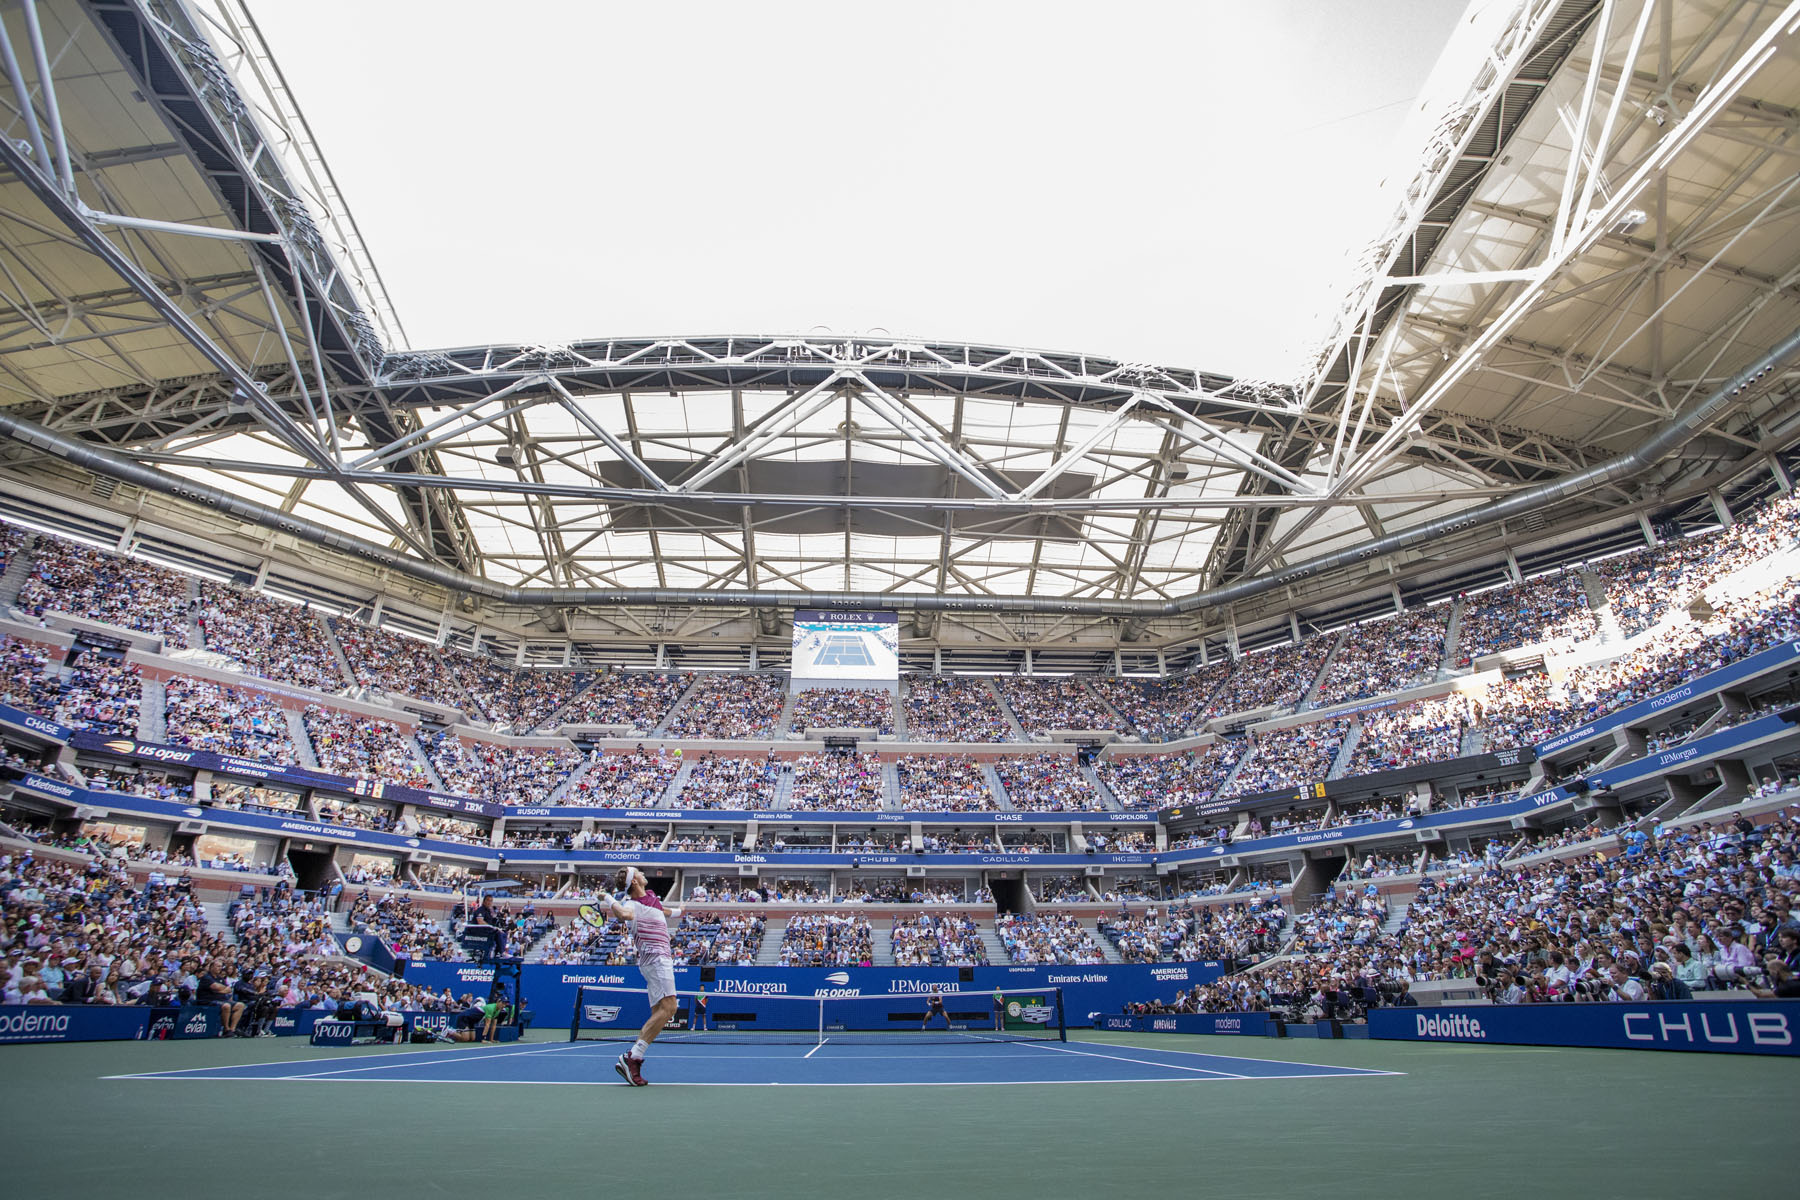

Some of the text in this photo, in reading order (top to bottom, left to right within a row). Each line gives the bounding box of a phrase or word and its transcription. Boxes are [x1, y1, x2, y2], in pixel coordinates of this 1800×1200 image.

[1650, 687, 1692, 708] moderna
[25, 717, 60, 735] CHASE
[1542, 726, 1594, 752] AMERICAN EXPRESS
[137, 745, 193, 762] us open
[1659, 747, 1698, 766] J.P.Morgan
[229, 758, 250, 767] KAREN
[250, 762, 287, 773] KHACHANOV
[1499, 755, 1520, 767] IBM
[227, 766, 250, 775] CASPER
[250, 769, 269, 778] RUUD
[26, 777, 74, 797] ticketmaster
[1215, 799, 1241, 807] KHACHANOV
[1534, 791, 1559, 806] WTA
[464, 801, 485, 813] IBM
[877, 814, 905, 822] J.P.Morgan
[281, 822, 357, 838] AMERICAN EXPRESS
[1297, 831, 1343, 843] Emirates Airline
[604, 852, 641, 860] moderna
[734, 854, 767, 863] Deloitte.
[1150, 967, 1187, 975] AMERICAN
[562, 974, 625, 984] Emirates Airline
[1048, 974, 1108, 983] Emirates Airline
[714, 979, 788, 995] J.P.Morgan
[814, 988, 859, 998] us open
[153, 1021, 174, 1031] evian
[185, 1022, 207, 1033] evian
[275, 1017, 295, 1027] Wilson
[1108, 1018, 1132, 1028] CADILLAC
[1215, 1016, 1241, 1029] moderna
[1416, 1013, 1486, 1038] Deloitte.
[319, 1025, 352, 1038] POLO
